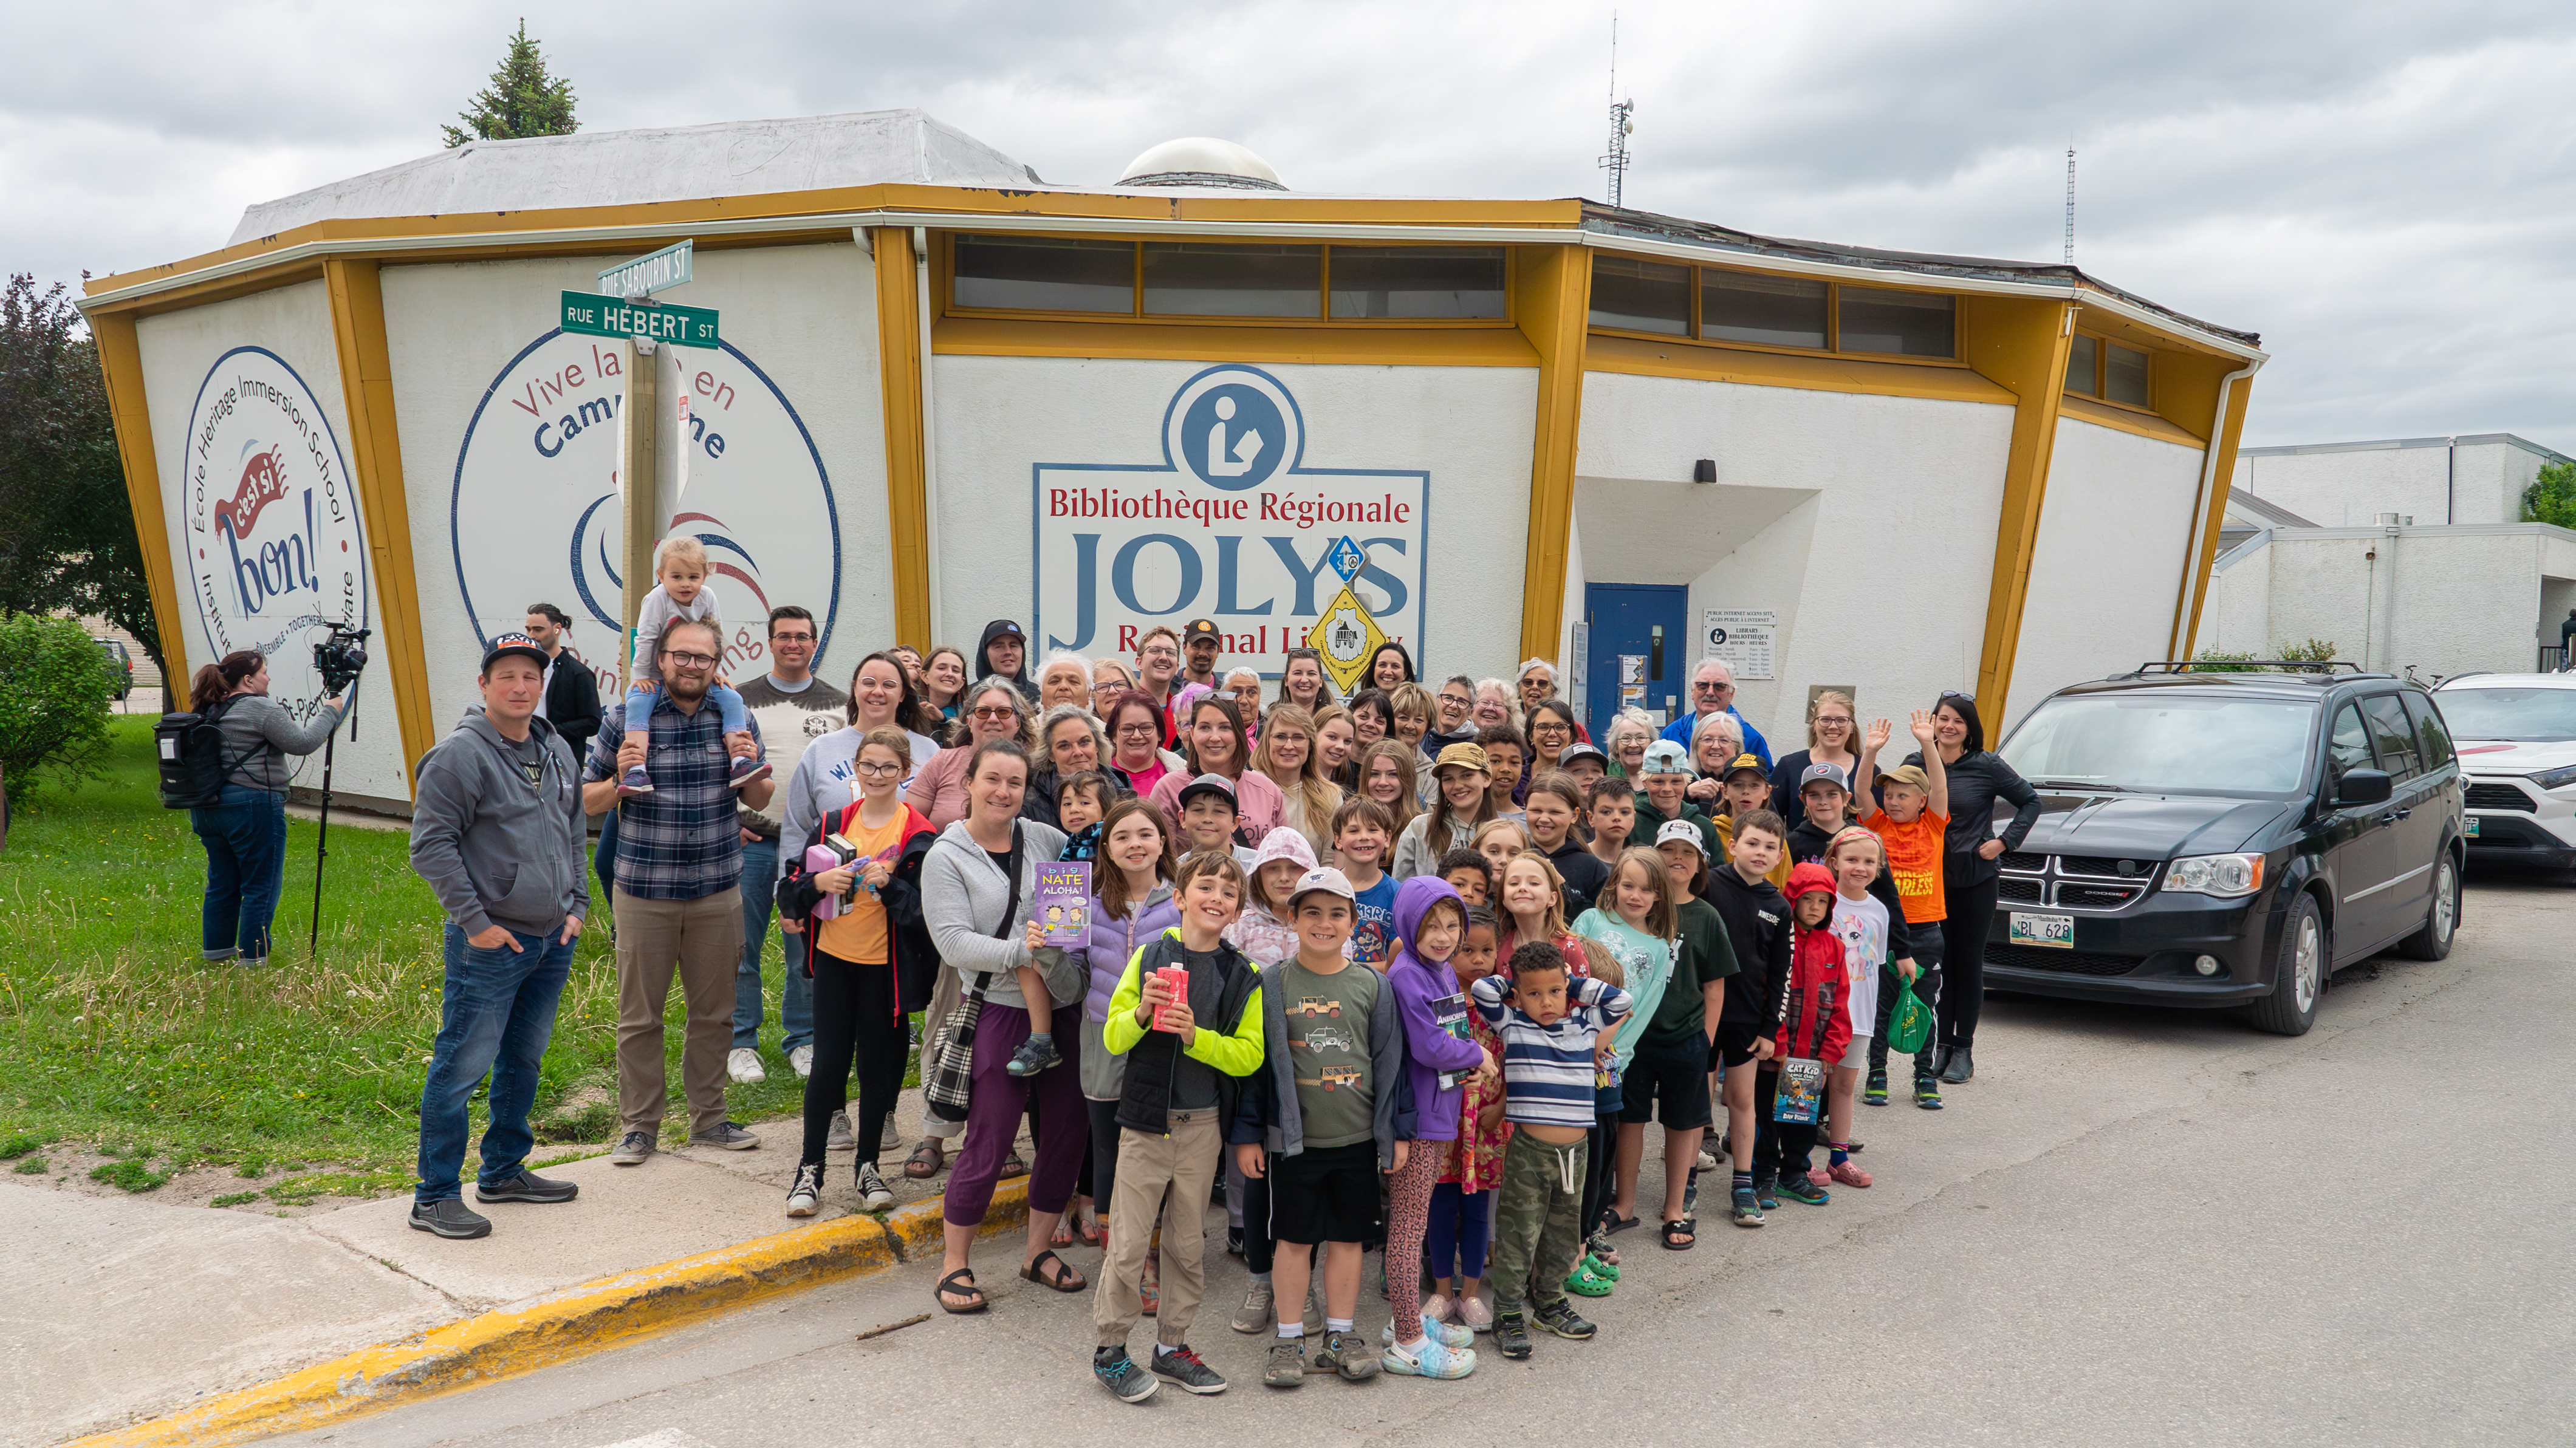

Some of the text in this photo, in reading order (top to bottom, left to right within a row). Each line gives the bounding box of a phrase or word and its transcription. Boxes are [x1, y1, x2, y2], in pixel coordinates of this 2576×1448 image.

[602, 247, 687, 297] RUE SABOURIN ST
[567, 304, 714, 340] RUE HÉBERT ST
[511, 364, 586, 418] Vive
[592, 344, 623, 378] la
[694, 371, 735, 411] en
[191, 375, 346, 533] École Héritage Immersion School
[236, 457, 275, 527] c'est si
[1049, 487, 1411, 529] Bibliothèque Régionale
[218, 487, 319, 621] bon!
[1049, 533, 1408, 652] JOLYS
[256, 614, 322, 656] ENSEMBLE TOGETHER
[1043, 874, 1084, 886] NATE
[1043, 886, 1083, 895] ALOHA!
[1356, 903, 1393, 923] MARIO
[2045, 923, 2070, 939] 628
[1787, 1064, 1804, 1073] CAT
